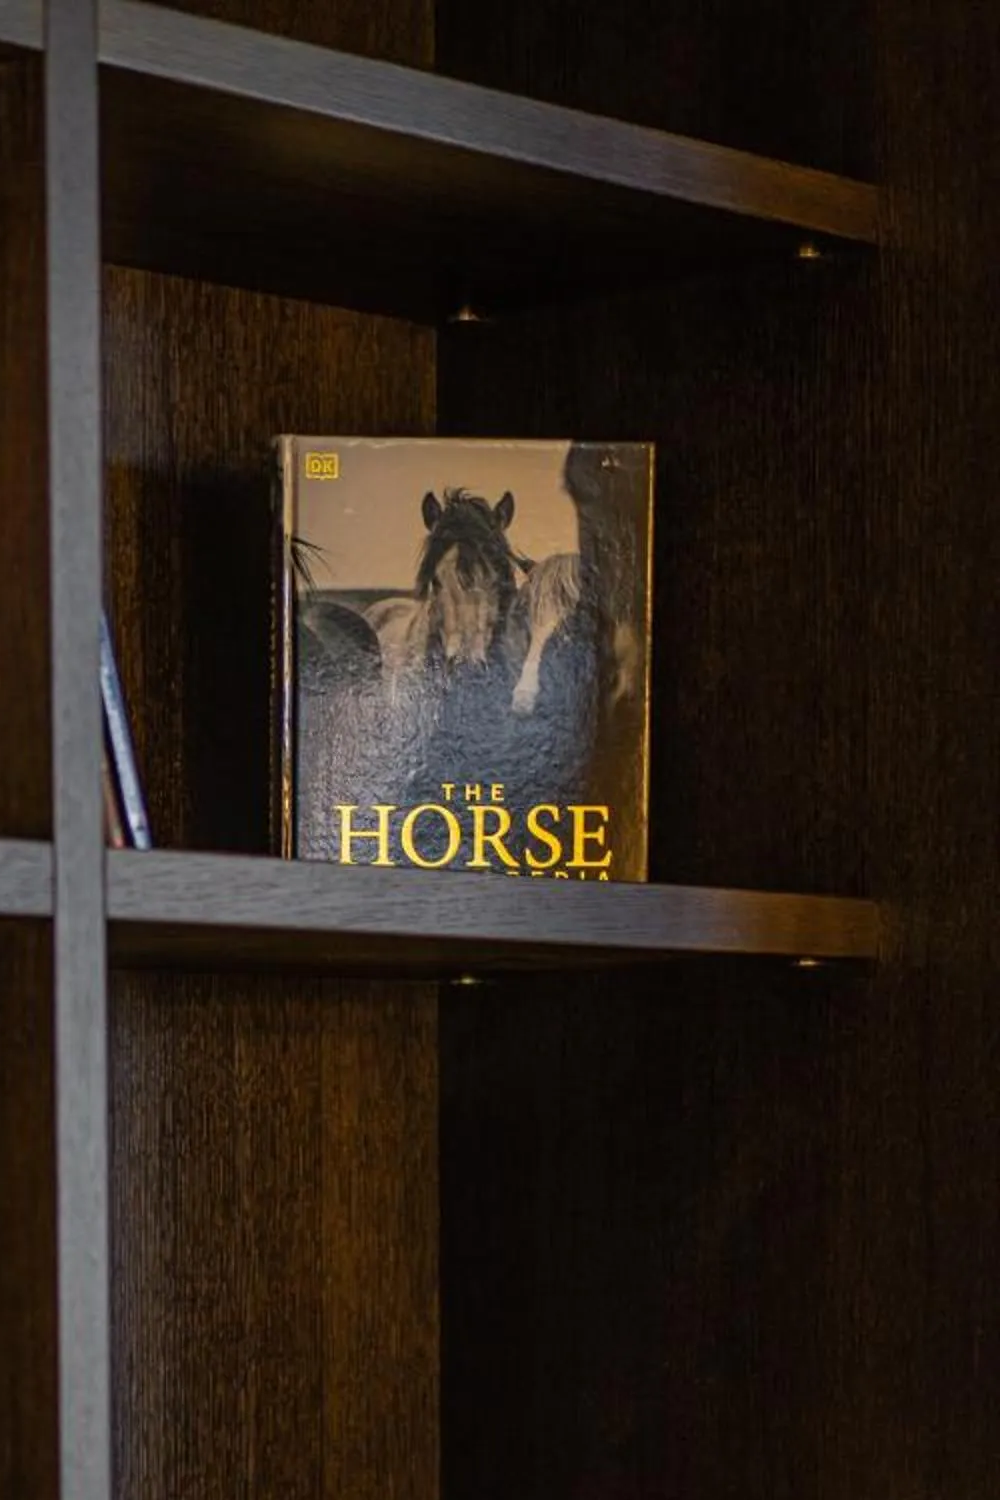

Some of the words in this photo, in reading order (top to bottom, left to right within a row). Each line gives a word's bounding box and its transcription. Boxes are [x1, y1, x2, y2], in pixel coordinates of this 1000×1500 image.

[311, 459, 333, 473] DK
[441, 783, 505, 801] THE
[334, 804, 613, 868] HORSE
